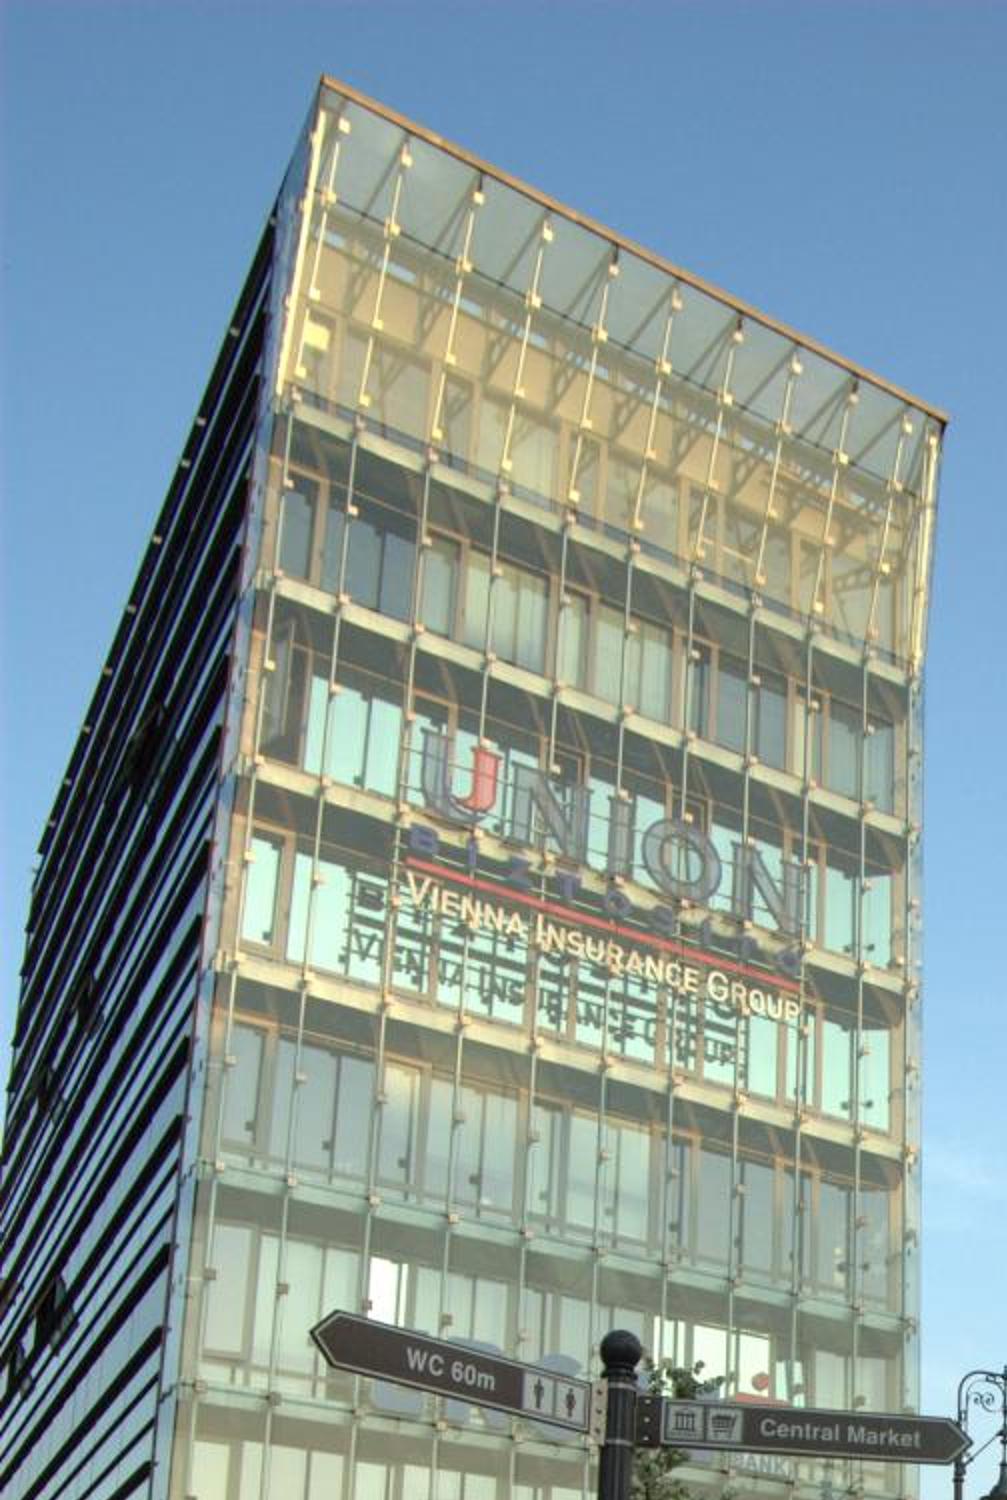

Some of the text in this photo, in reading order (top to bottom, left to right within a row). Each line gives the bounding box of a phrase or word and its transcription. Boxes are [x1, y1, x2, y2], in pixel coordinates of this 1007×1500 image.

[420, 728, 811, 938] UNION
[404, 871, 530, 938] VIENNA
[534, 911, 701, 994] INSURANCE
[705, 970, 802, 1023] GROUP
[405, 1346, 496, 1391] WC 60m
[759, 1417, 921, 1448] Central Market
